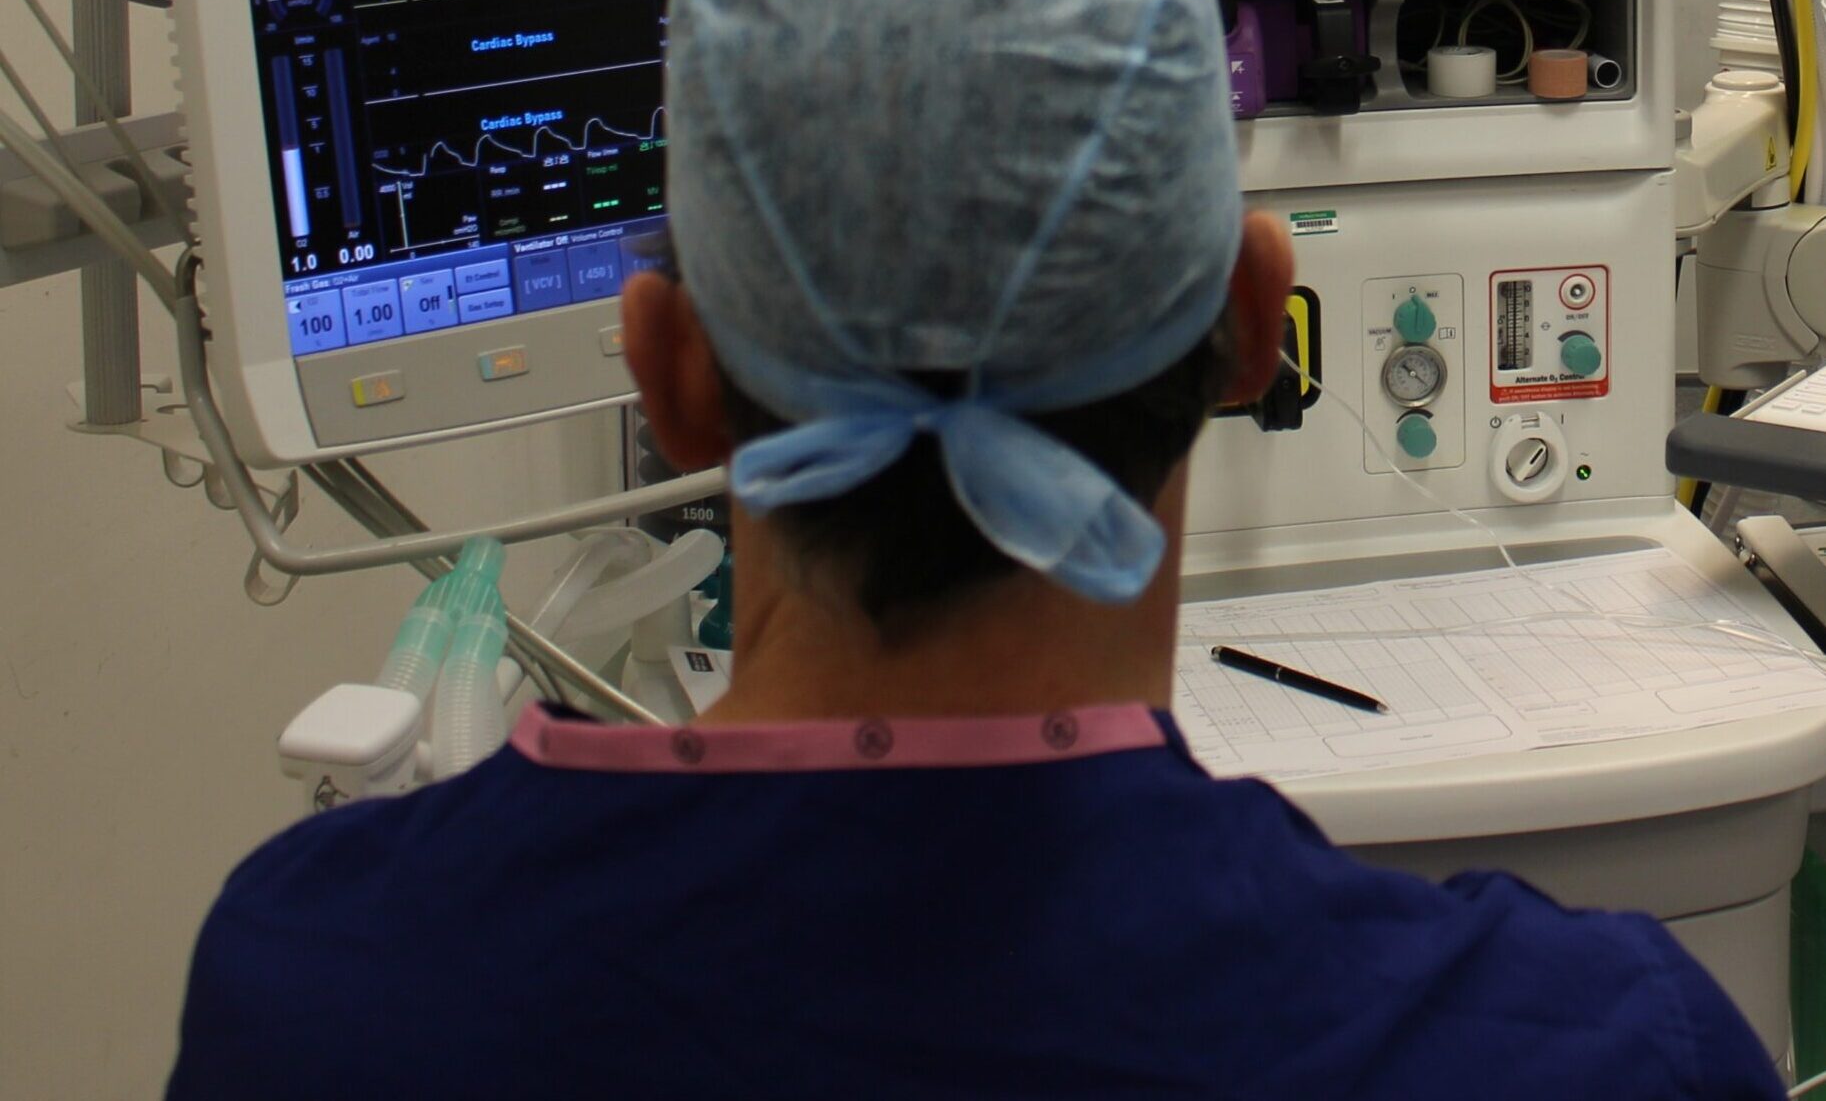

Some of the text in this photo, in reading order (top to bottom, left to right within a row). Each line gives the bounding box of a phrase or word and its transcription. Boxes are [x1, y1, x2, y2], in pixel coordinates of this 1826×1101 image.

[471, 32, 554, 52] Cardiac Bypass
[481, 110, 563, 131] Cardiac Bypass
[598, 227, 623, 238] Control
[291, 244, 374, 273] 1.0 0.00
[419, 295, 440, 312] Off
[354, 303, 393, 326] 1.00
[300, 314, 333, 336] 100
[1515, 375, 1547, 383] Alternate
[1559, 373, 1585, 381] Contro
[682, 506, 714, 521] 1500
